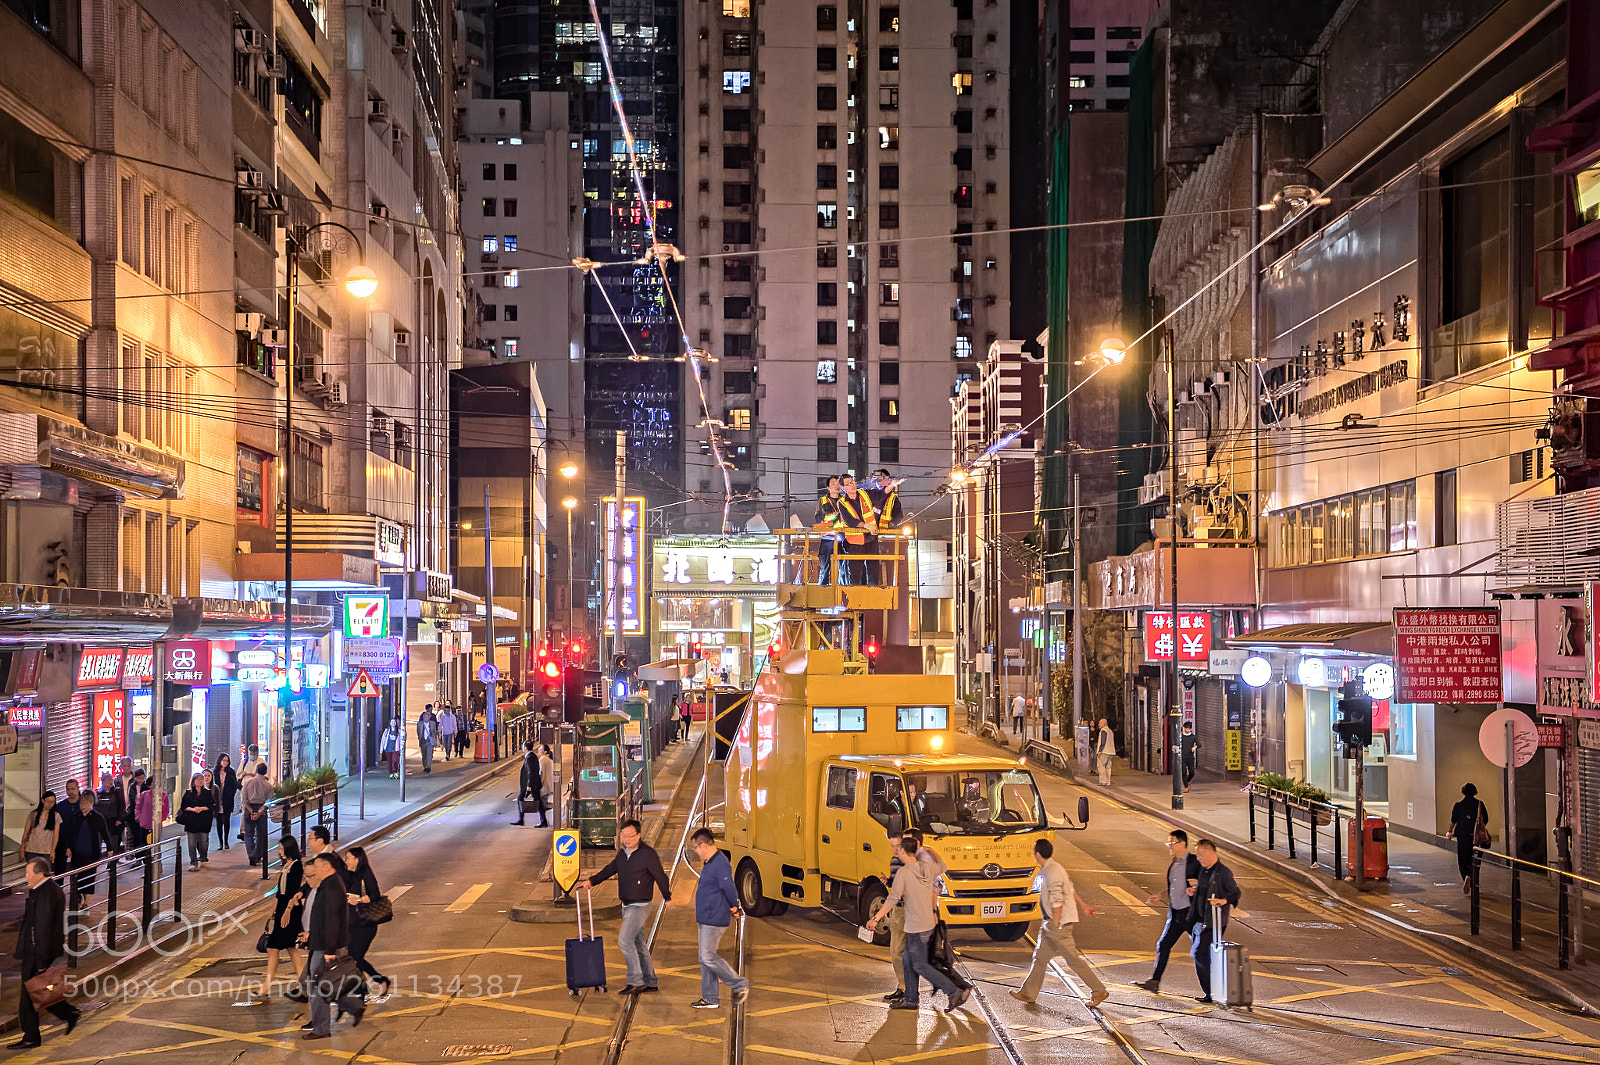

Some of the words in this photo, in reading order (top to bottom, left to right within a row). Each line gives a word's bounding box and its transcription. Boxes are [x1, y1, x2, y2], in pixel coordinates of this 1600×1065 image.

[1400, 614, 1497, 626] 永盛外幣找換有限公司
[1406, 635, 1491, 646] 中港兩地私人公司
[164, 670, 203, 680] 大新銀行
[114, 699, 123, 749] MONEY
[98, 700, 114, 786] 人民幣
[982, 905, 1004, 915] 6017
